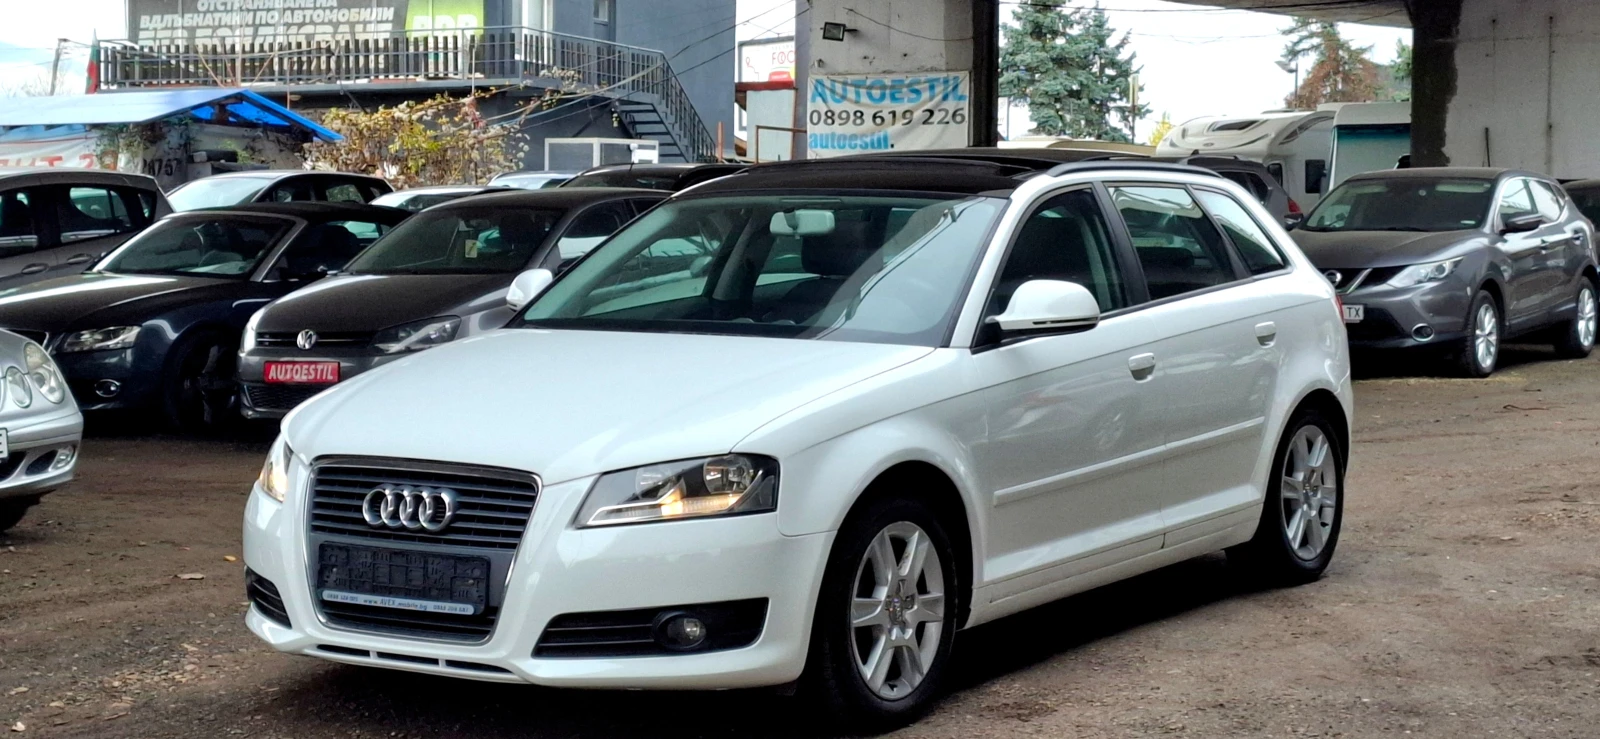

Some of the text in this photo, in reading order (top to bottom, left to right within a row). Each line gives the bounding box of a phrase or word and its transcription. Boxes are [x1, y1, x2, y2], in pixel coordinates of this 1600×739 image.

[140, 7, 394, 30] ВДЛЪБНАТИНИ ПО АВТОМОБИЛИ
[810, 76, 968, 104] AUTOESTIL
[808, 107, 966, 126] 0898 619 226
[1346, 307, 1360, 318] TX
[268, 365, 333, 380] AUTOESTIL
